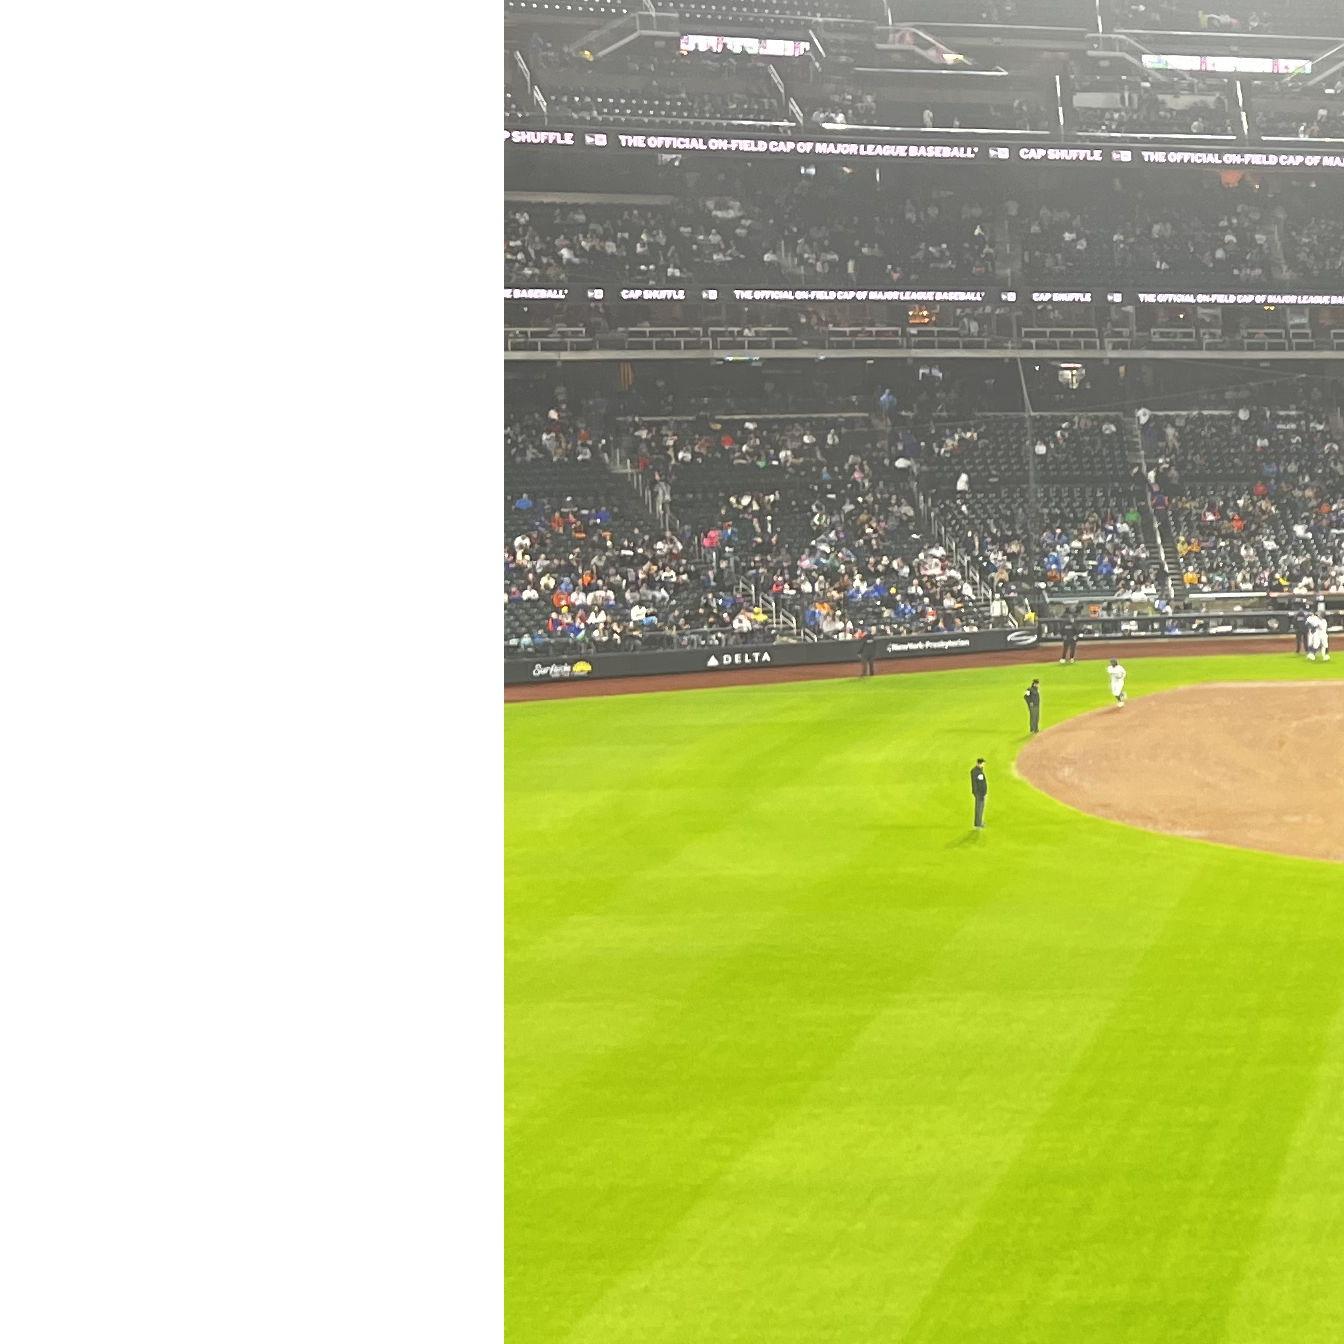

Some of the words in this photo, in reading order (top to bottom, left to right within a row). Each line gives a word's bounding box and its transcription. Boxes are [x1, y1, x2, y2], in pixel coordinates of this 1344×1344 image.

[511, 130, 574, 145] SHUFFLE
[618, 134, 646, 148] THE
[649, 135, 707, 151] OFFICIAL
[708, 138, 767, 152] ON-FIELD
[769, 140, 796, 153] CAP
[797, 141, 814, 154] OF
[815, 142, 858, 155] MAJOR
[859, 143, 908, 157] LEAGUE
[909, 145, 978, 158] BASEBALL
[1019, 147, 1046, 160] CAP
[1047, 148, 1103, 161] SHUFFLE
[1142, 150, 1166, 163] THE
[1167, 151, 1222, 165] OFFICIAL
[1279, 154, 1304, 166] CAP
[1305, 155, 1321, 167] OF
[722, 651, 771, 665] DELTA
